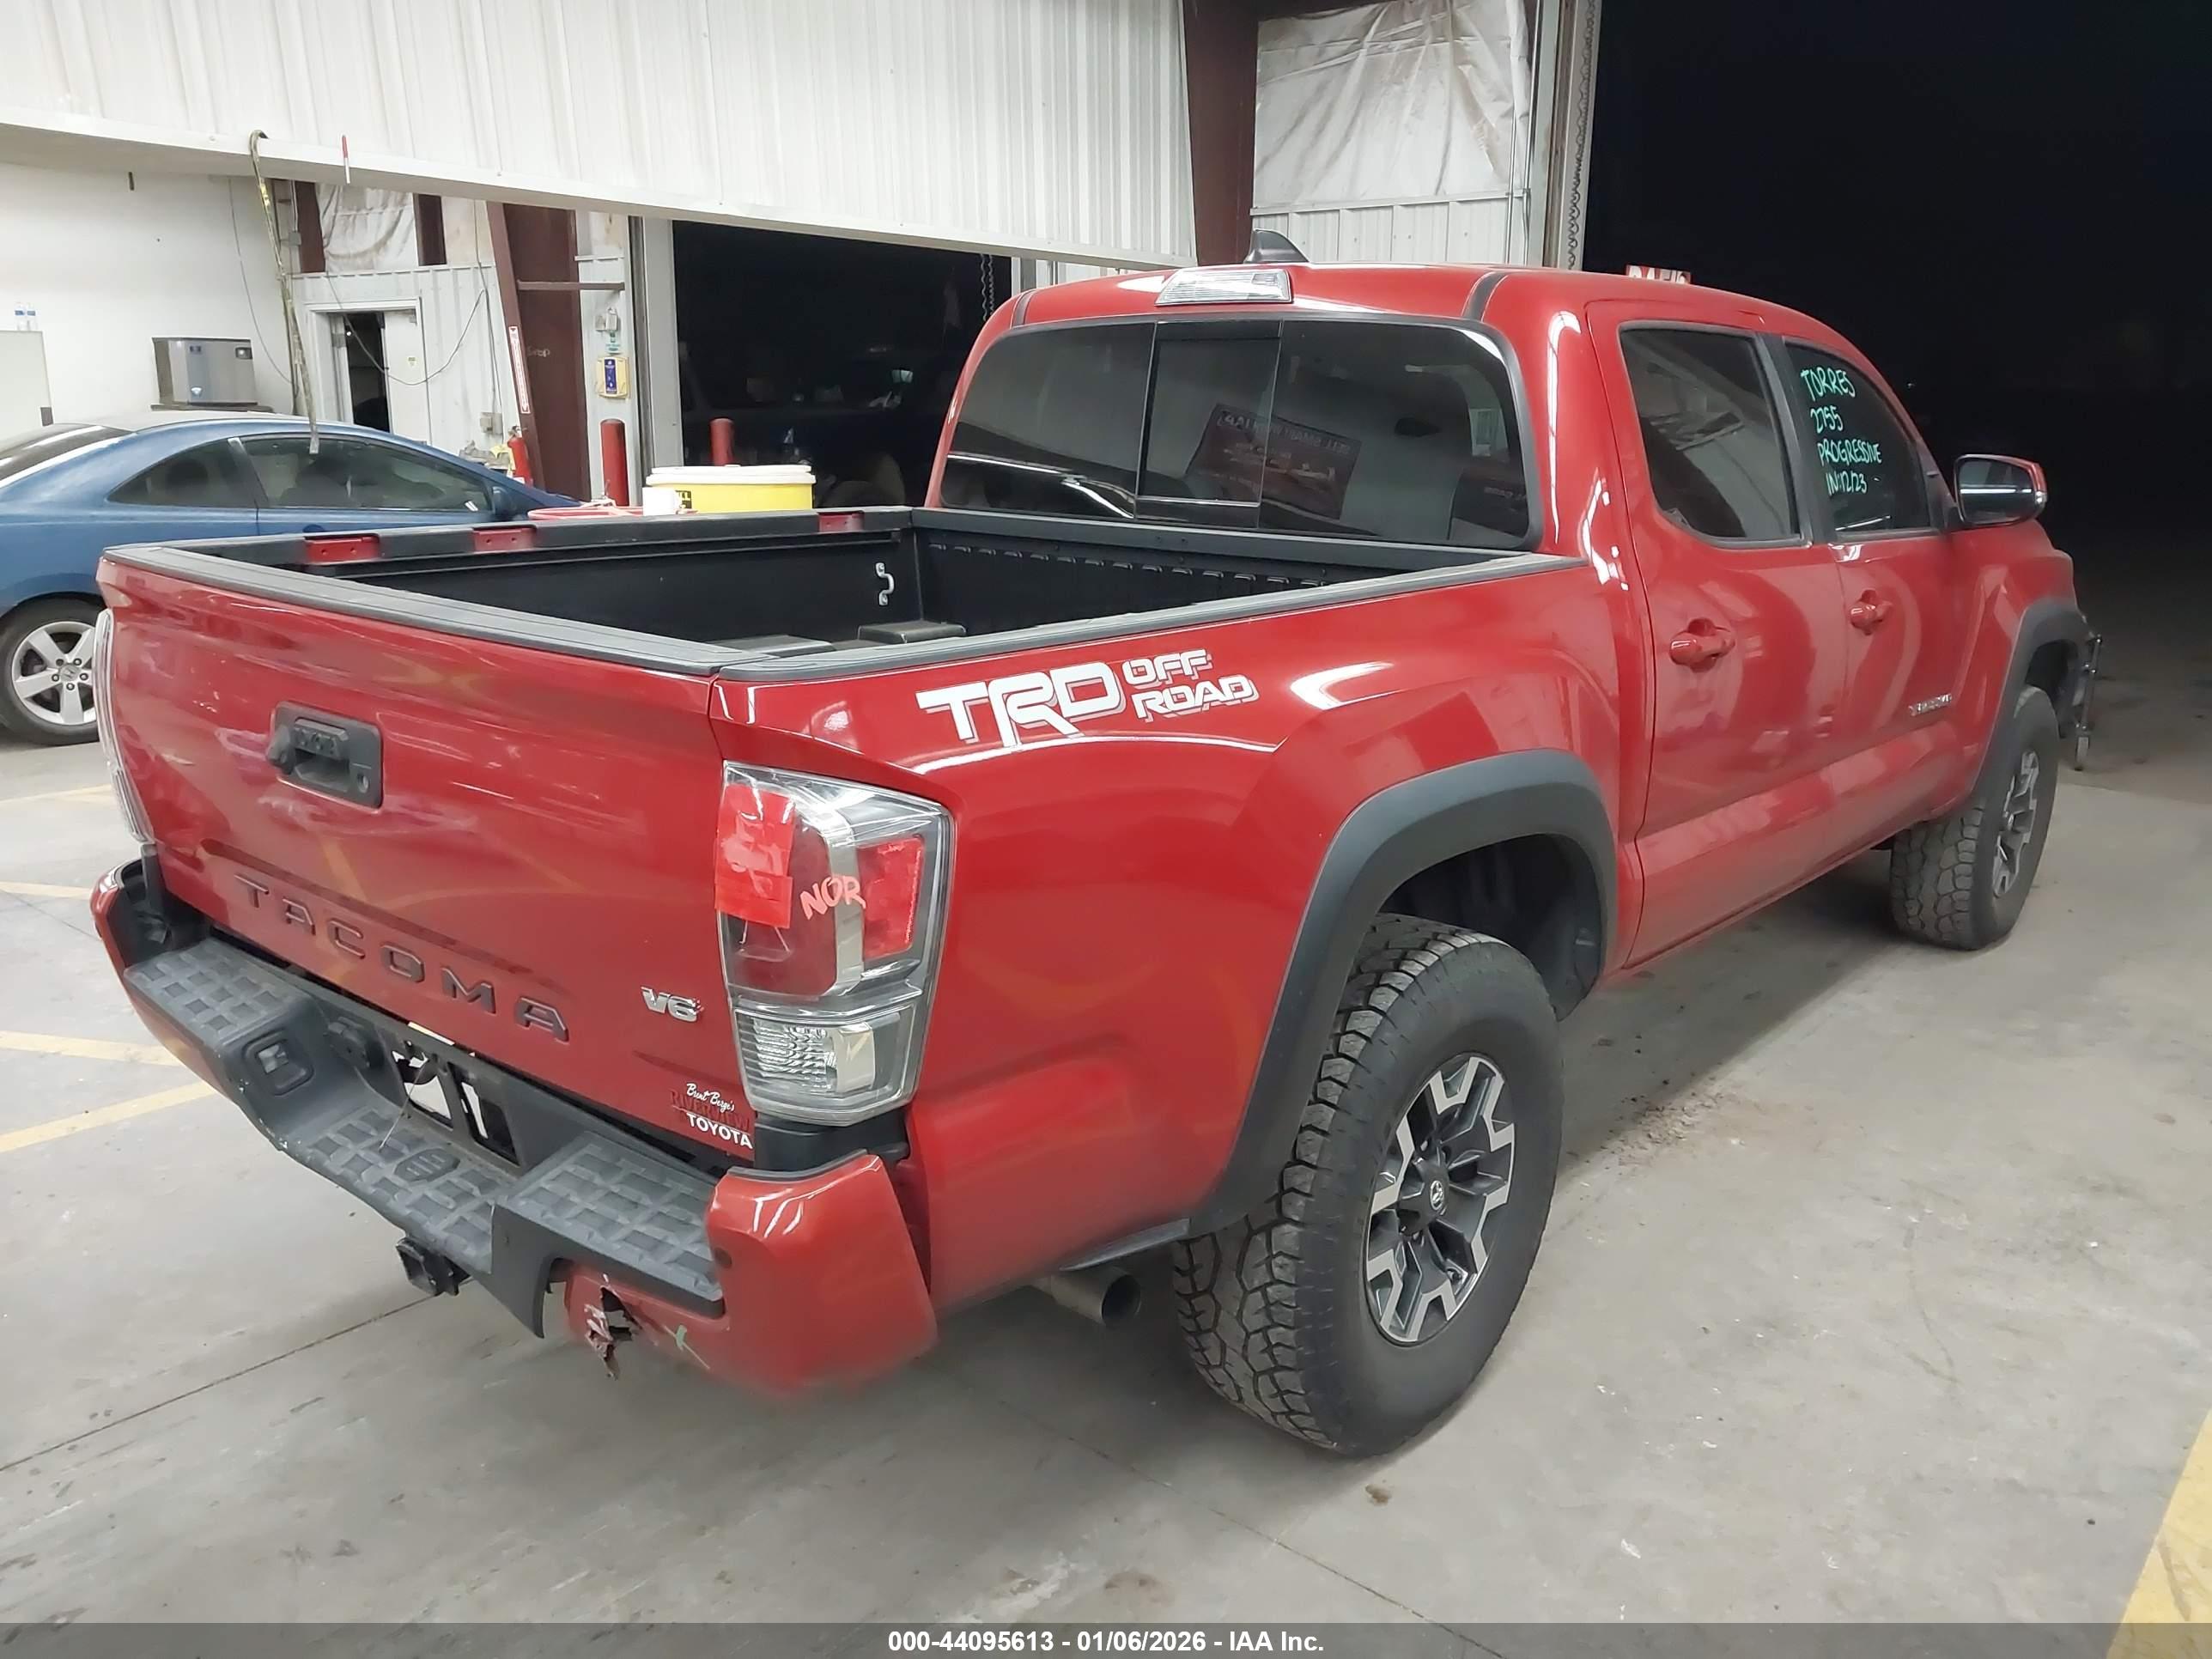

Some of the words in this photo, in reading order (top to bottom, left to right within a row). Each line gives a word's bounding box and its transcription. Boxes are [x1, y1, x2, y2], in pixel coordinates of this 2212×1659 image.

[1801, 367, 1856, 401] TORRES
[1810, 405, 1844, 433] 2755
[1817, 438, 1882, 466] PROGRESSIVE
[1122, 649, 1212, 684] OFF
[915, 661, 1126, 748] TRD
[1131, 674, 1260, 722] ROAD
[799, 875, 866, 921] NOR
[234, 872, 570, 1045] TACOMA
[641, 987, 700, 1023] V6
[686, 1113, 753, 1150] TOYOTA
